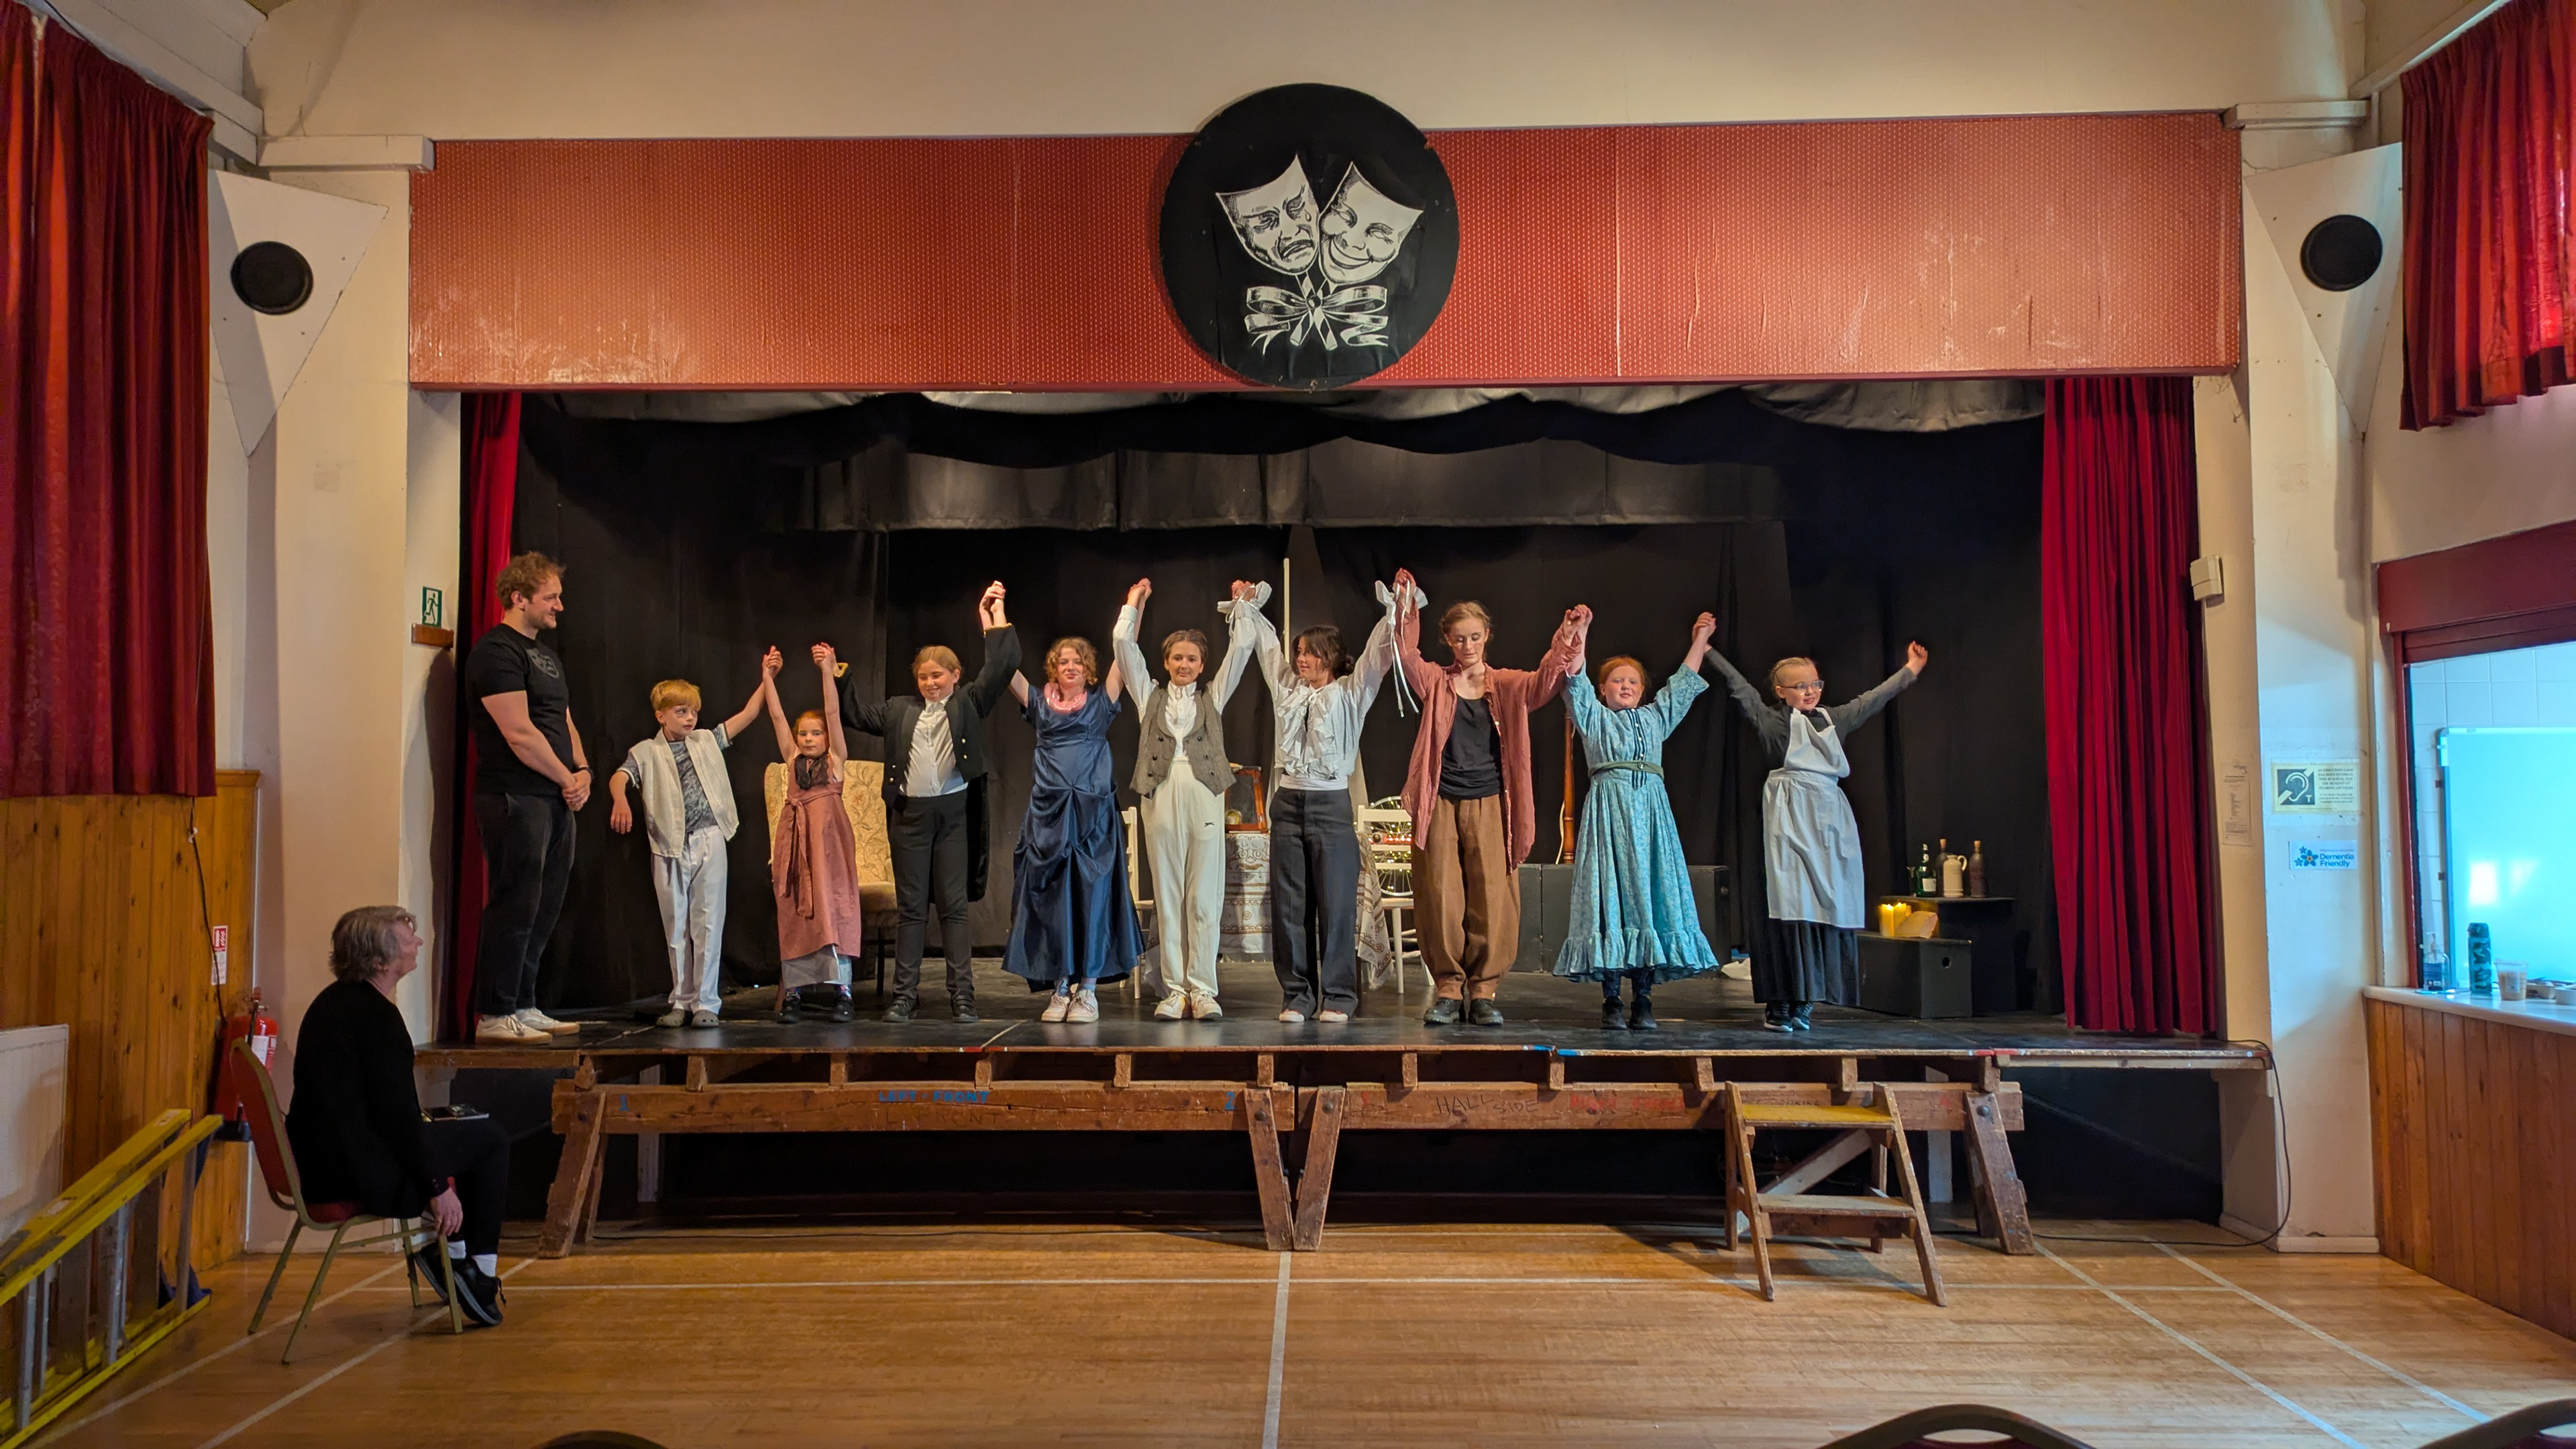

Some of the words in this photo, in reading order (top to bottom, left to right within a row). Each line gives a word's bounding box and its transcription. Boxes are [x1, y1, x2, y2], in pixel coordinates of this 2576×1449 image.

[2306, 795, 2312, 803] T
[619, 1094, 629, 1111] 1
[879, 1091, 917, 1102] LEFT
[1225, 1091, 1235, 1110] 2
[1436, 1093, 1495, 1114] HALL
[1493, 1099, 1540, 1114] SIDE
